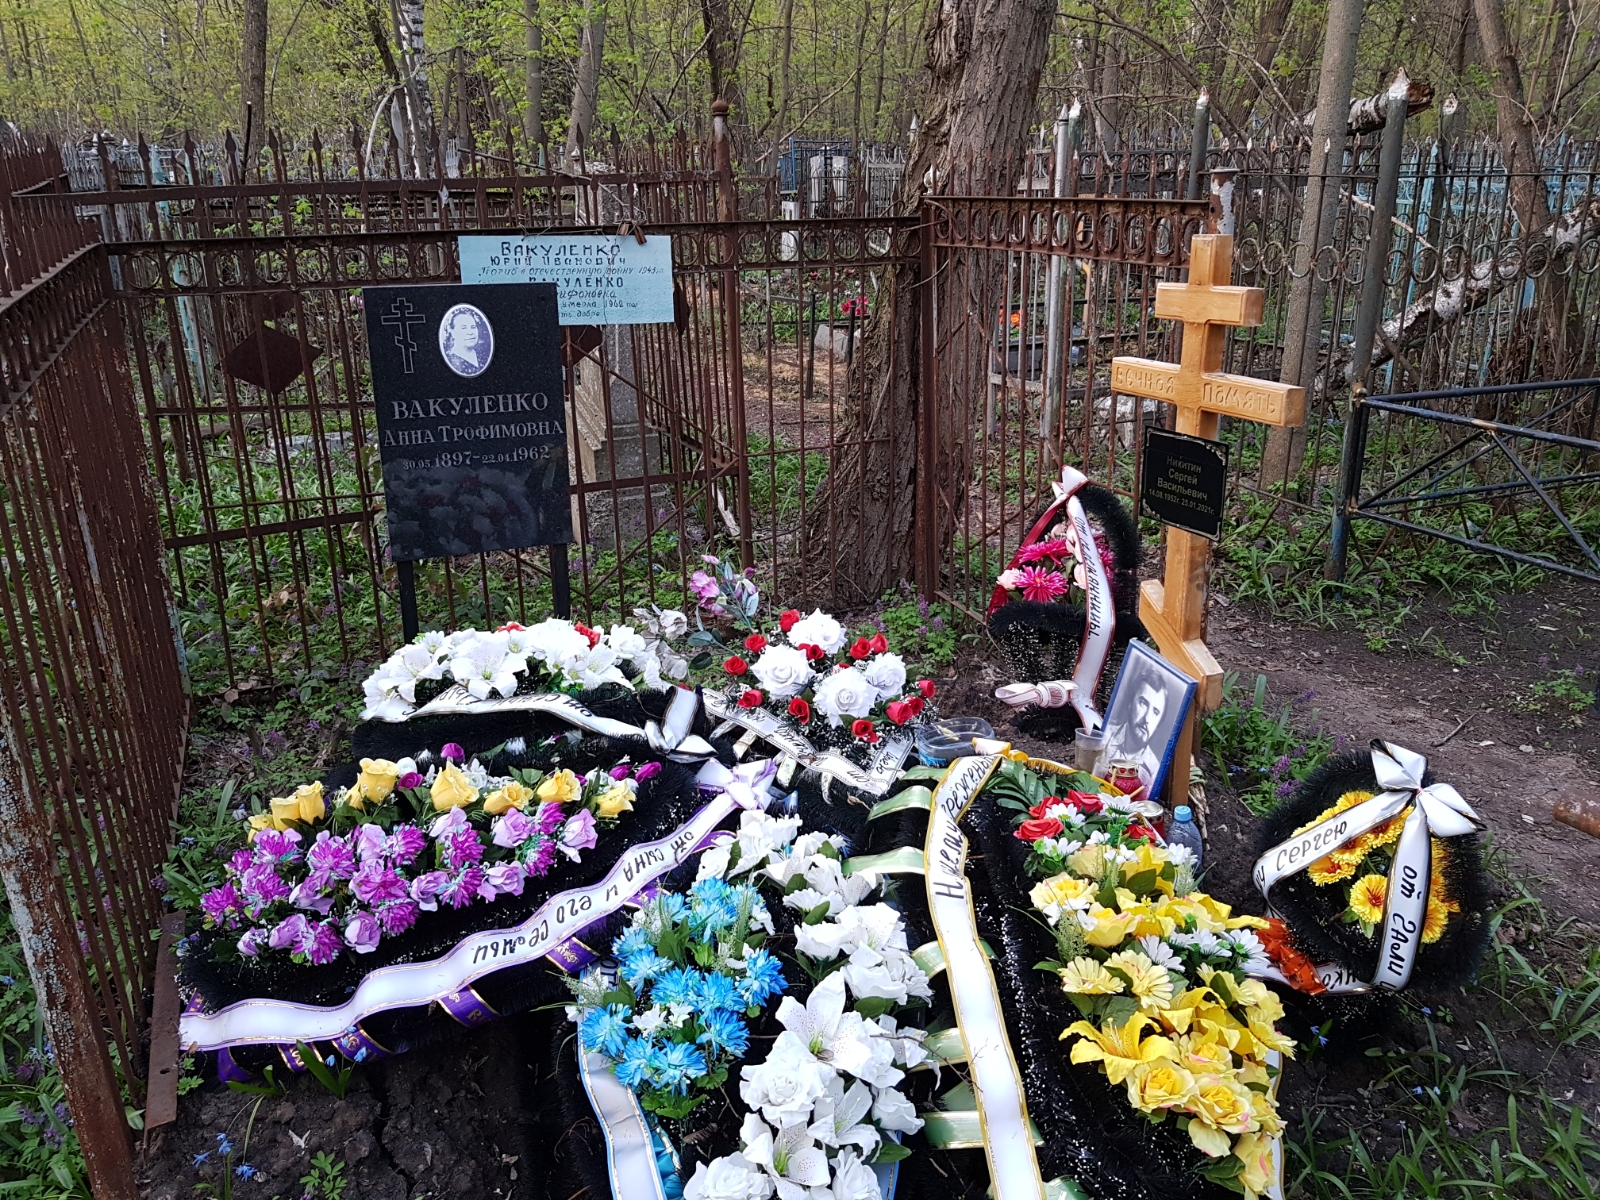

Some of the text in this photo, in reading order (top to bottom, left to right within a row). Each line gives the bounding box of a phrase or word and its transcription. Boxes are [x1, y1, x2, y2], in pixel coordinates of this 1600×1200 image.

[490, 256, 626, 266] ЮРИЙ ИВАНОВИЧ
[558, 289, 617, 300] ифоновна
[391, 392, 549, 420] ВАКУЛЕНКО
[384, 420, 565, 447] АННА ТРОФИМОВНА
[1166, 455, 1202, 474] Никитин
[1168, 468, 1198, 486] Сергей
[1157, 477, 1208, 502] Васильевич
[1276, 820, 1348, 872] Сергею
[556, 895, 592, 924] его
